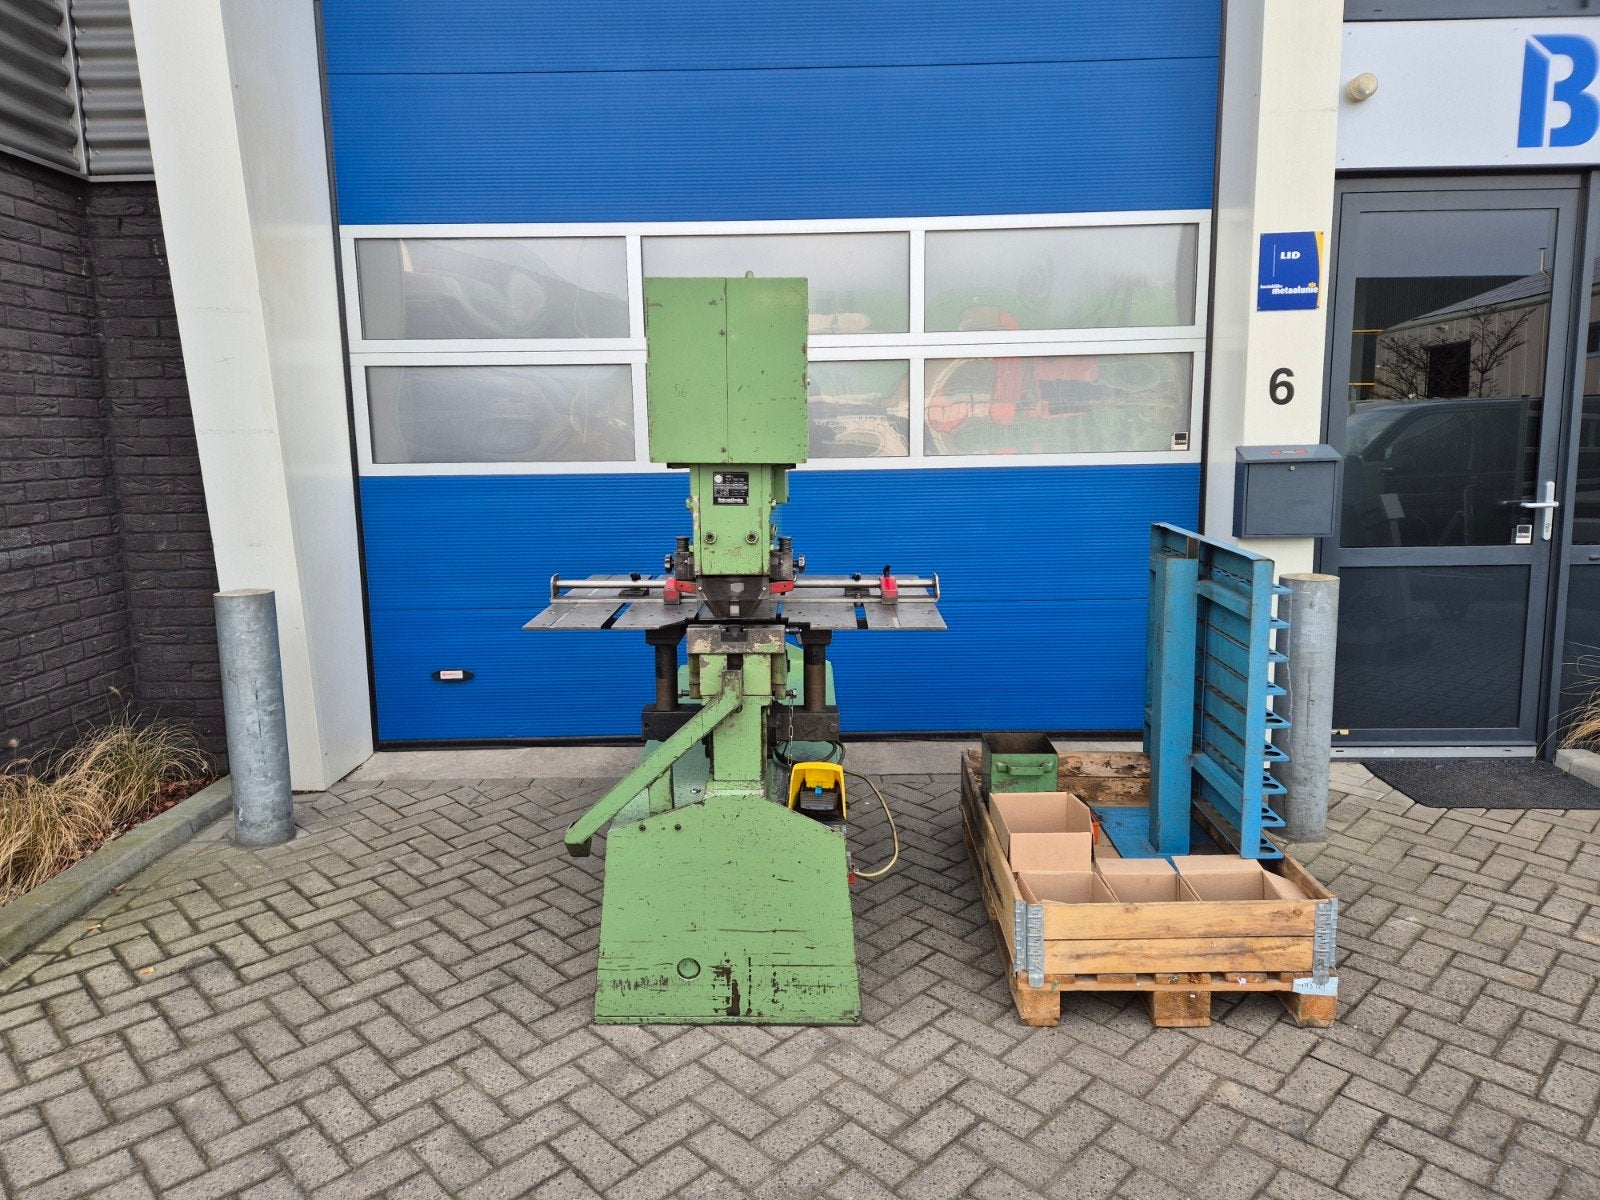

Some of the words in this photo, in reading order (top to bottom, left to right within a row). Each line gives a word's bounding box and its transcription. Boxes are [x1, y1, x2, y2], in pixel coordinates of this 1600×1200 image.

[1517, 33, 1600, 148] B
[1280, 250, 1301, 260] LID
[1269, 367, 1295, 406] 6
